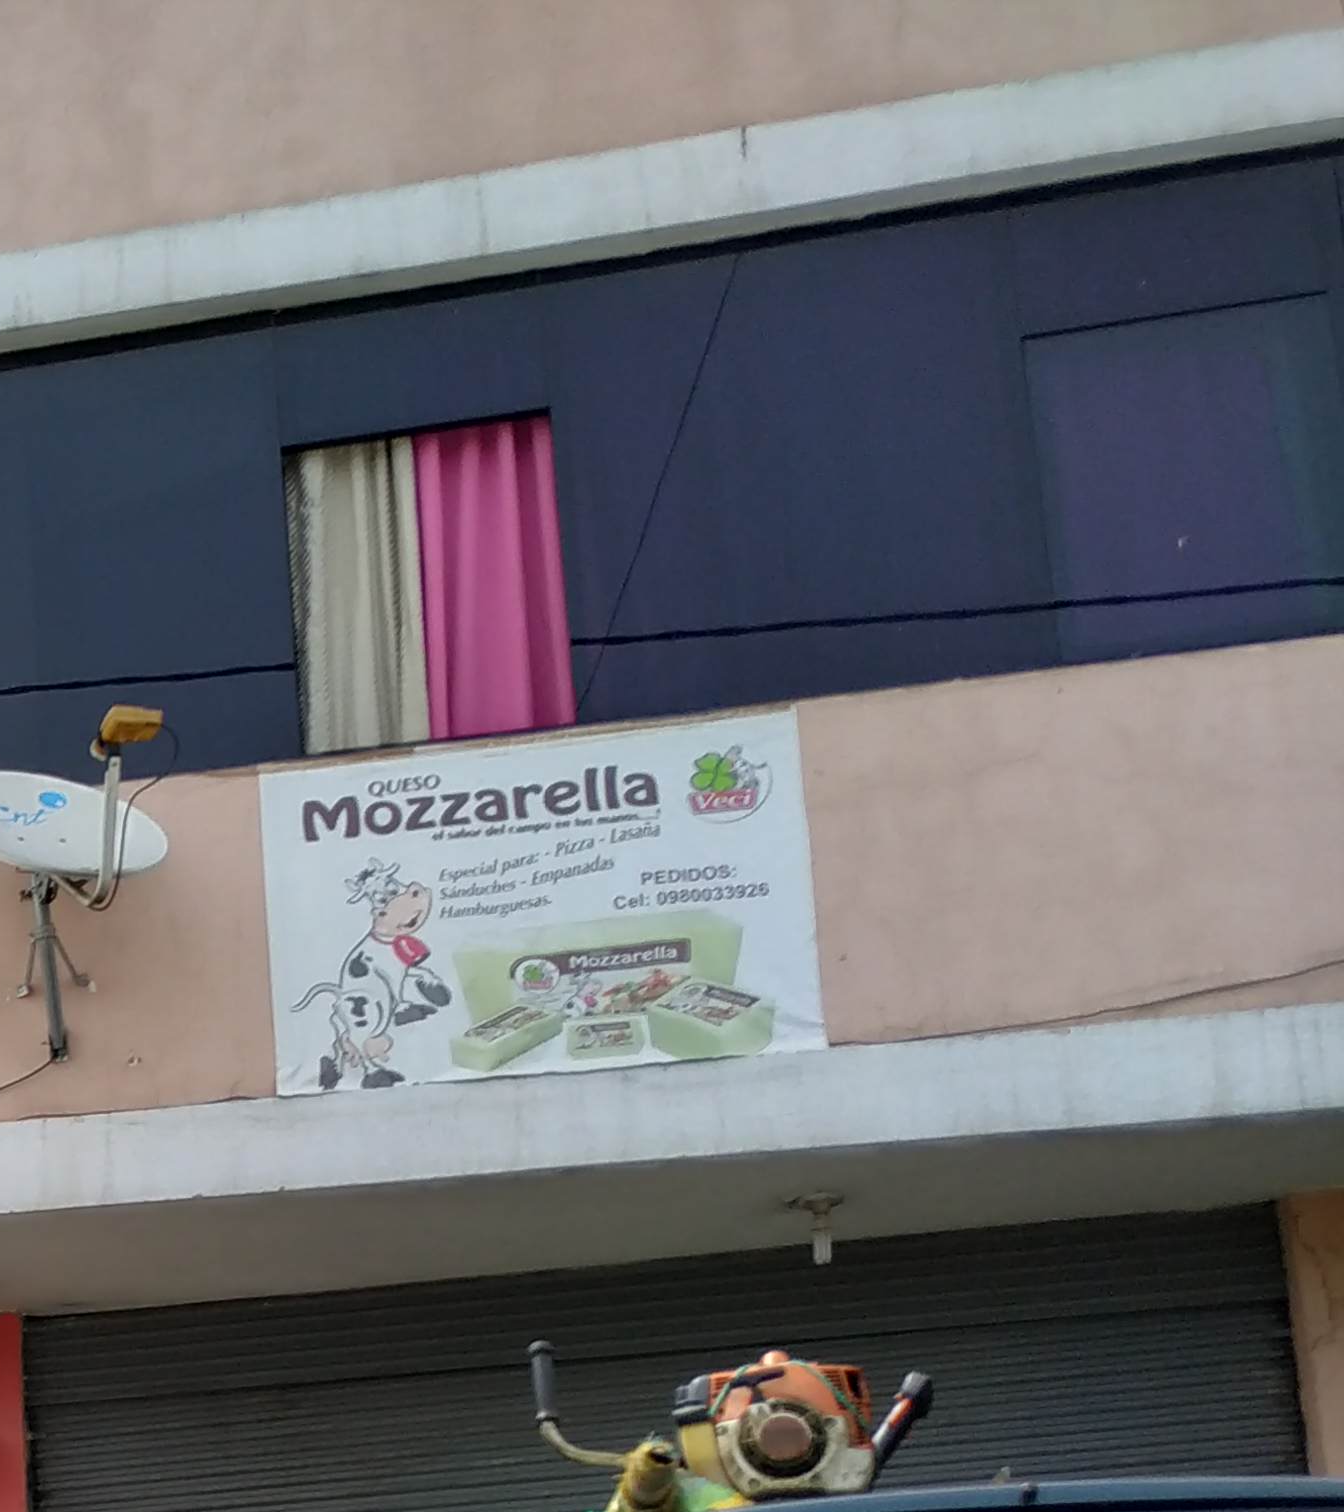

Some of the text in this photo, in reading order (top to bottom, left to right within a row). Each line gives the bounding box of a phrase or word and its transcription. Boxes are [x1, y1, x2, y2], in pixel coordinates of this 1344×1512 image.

[368, 775, 441, 797] QUESO
[302, 766, 660, 842] Mozzarella
[438, 858, 498, 884] Especial
[554, 838, 594, 858] Pizza
[610, 822, 661, 844] Lasaña
[530, 855, 615, 886] Empanadas
[640, 864, 737, 885] PEDIDOS:
[568, 945, 679, 969] Mozzarella
